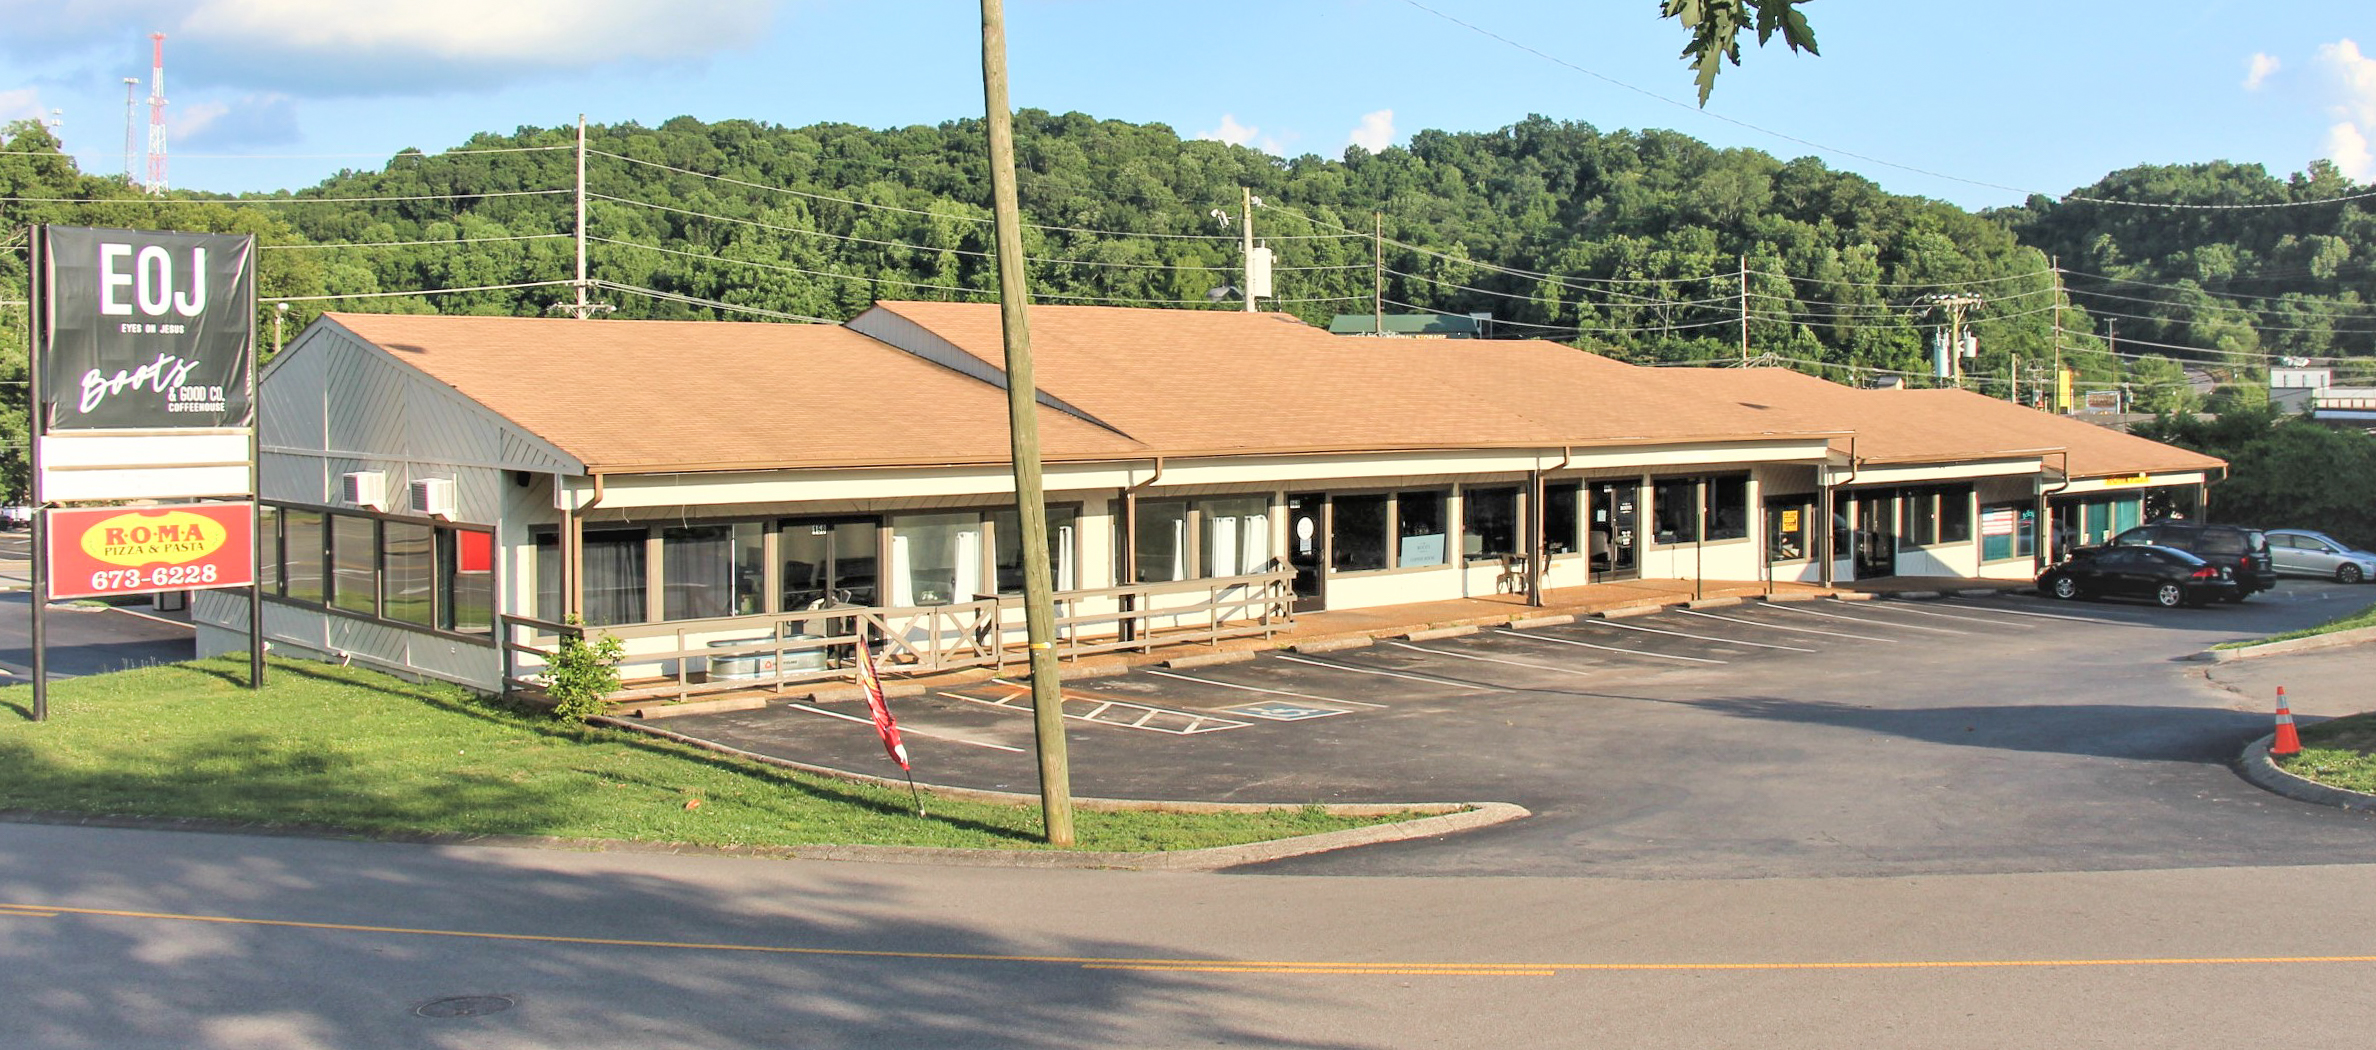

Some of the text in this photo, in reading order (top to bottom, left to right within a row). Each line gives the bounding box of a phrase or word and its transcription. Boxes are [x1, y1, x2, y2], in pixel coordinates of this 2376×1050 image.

[100, 243, 206, 317] EOJ
[121, 323, 185, 335] EYES ON JESUS
[80, 353, 199, 413] Boots
[168, 386, 226, 402] & GOOD CO.
[168, 402, 226, 412] COFFEEHOUSE
[104, 542, 204, 556] PIZZA & PASTA
[91, 564, 217, 590] 673-6228
